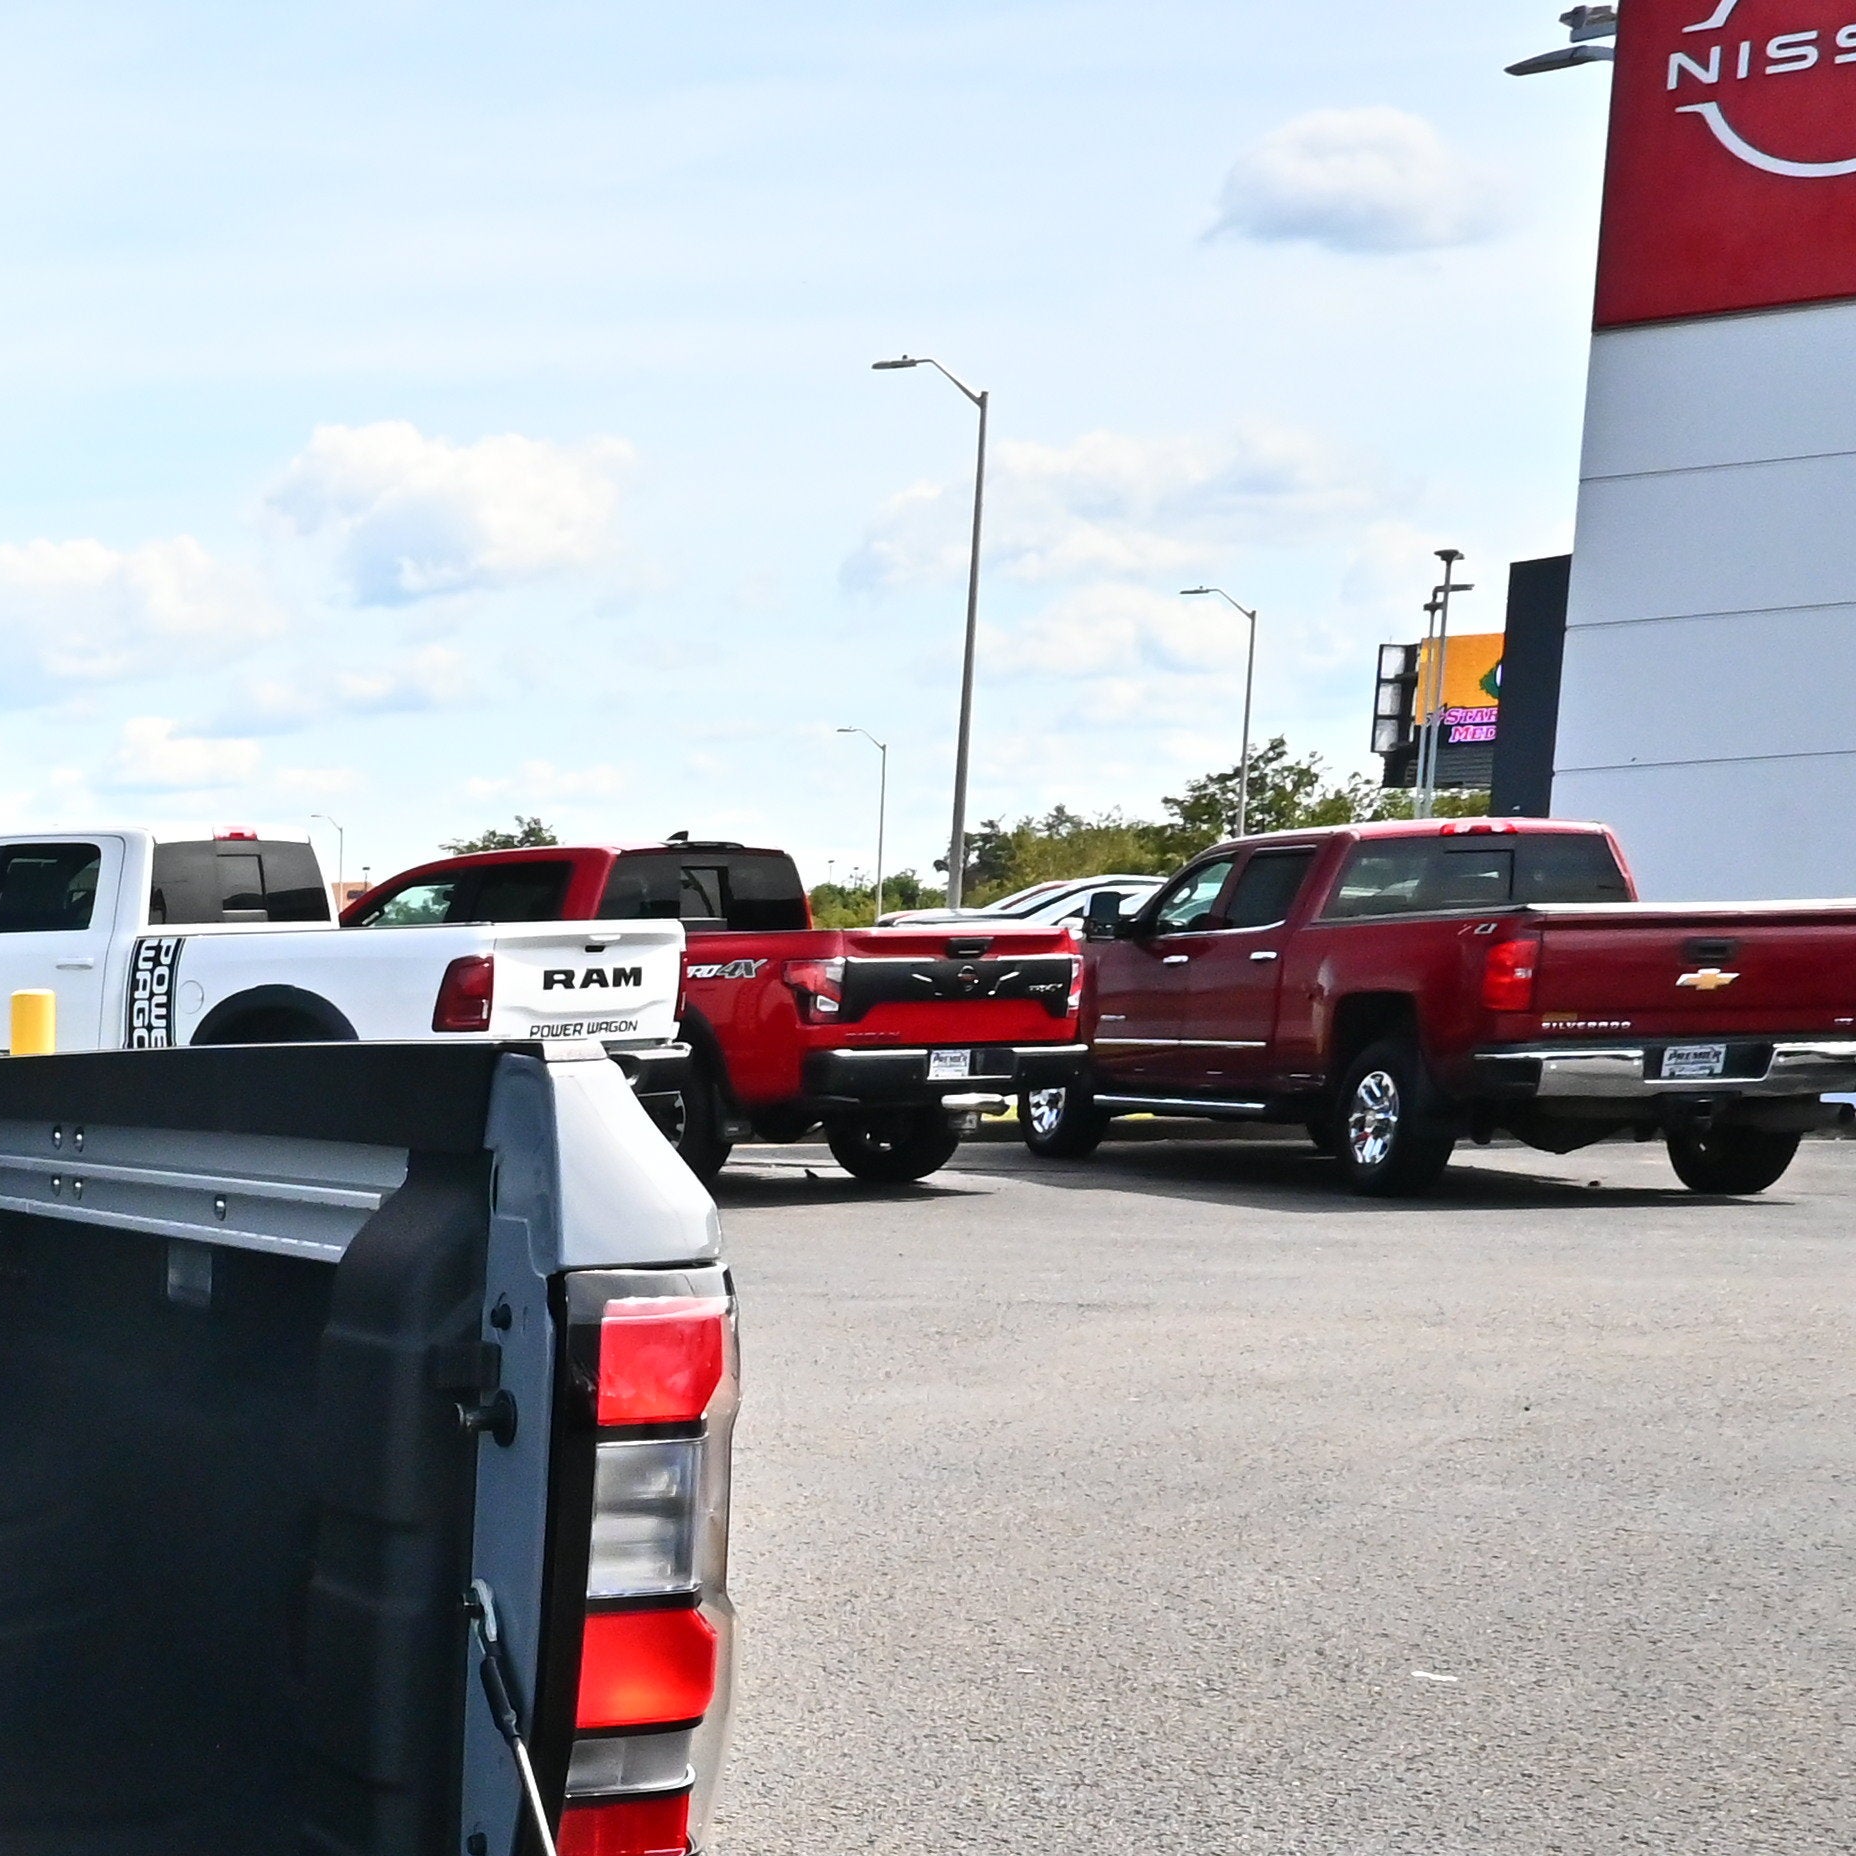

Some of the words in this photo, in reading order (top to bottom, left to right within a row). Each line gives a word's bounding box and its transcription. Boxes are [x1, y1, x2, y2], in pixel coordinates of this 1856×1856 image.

[543, 966, 643, 991] RAM
[686, 958, 768, 979] RO4X
[529, 1022, 584, 1039] POWER
[587, 1019, 639, 1035] WAGON
